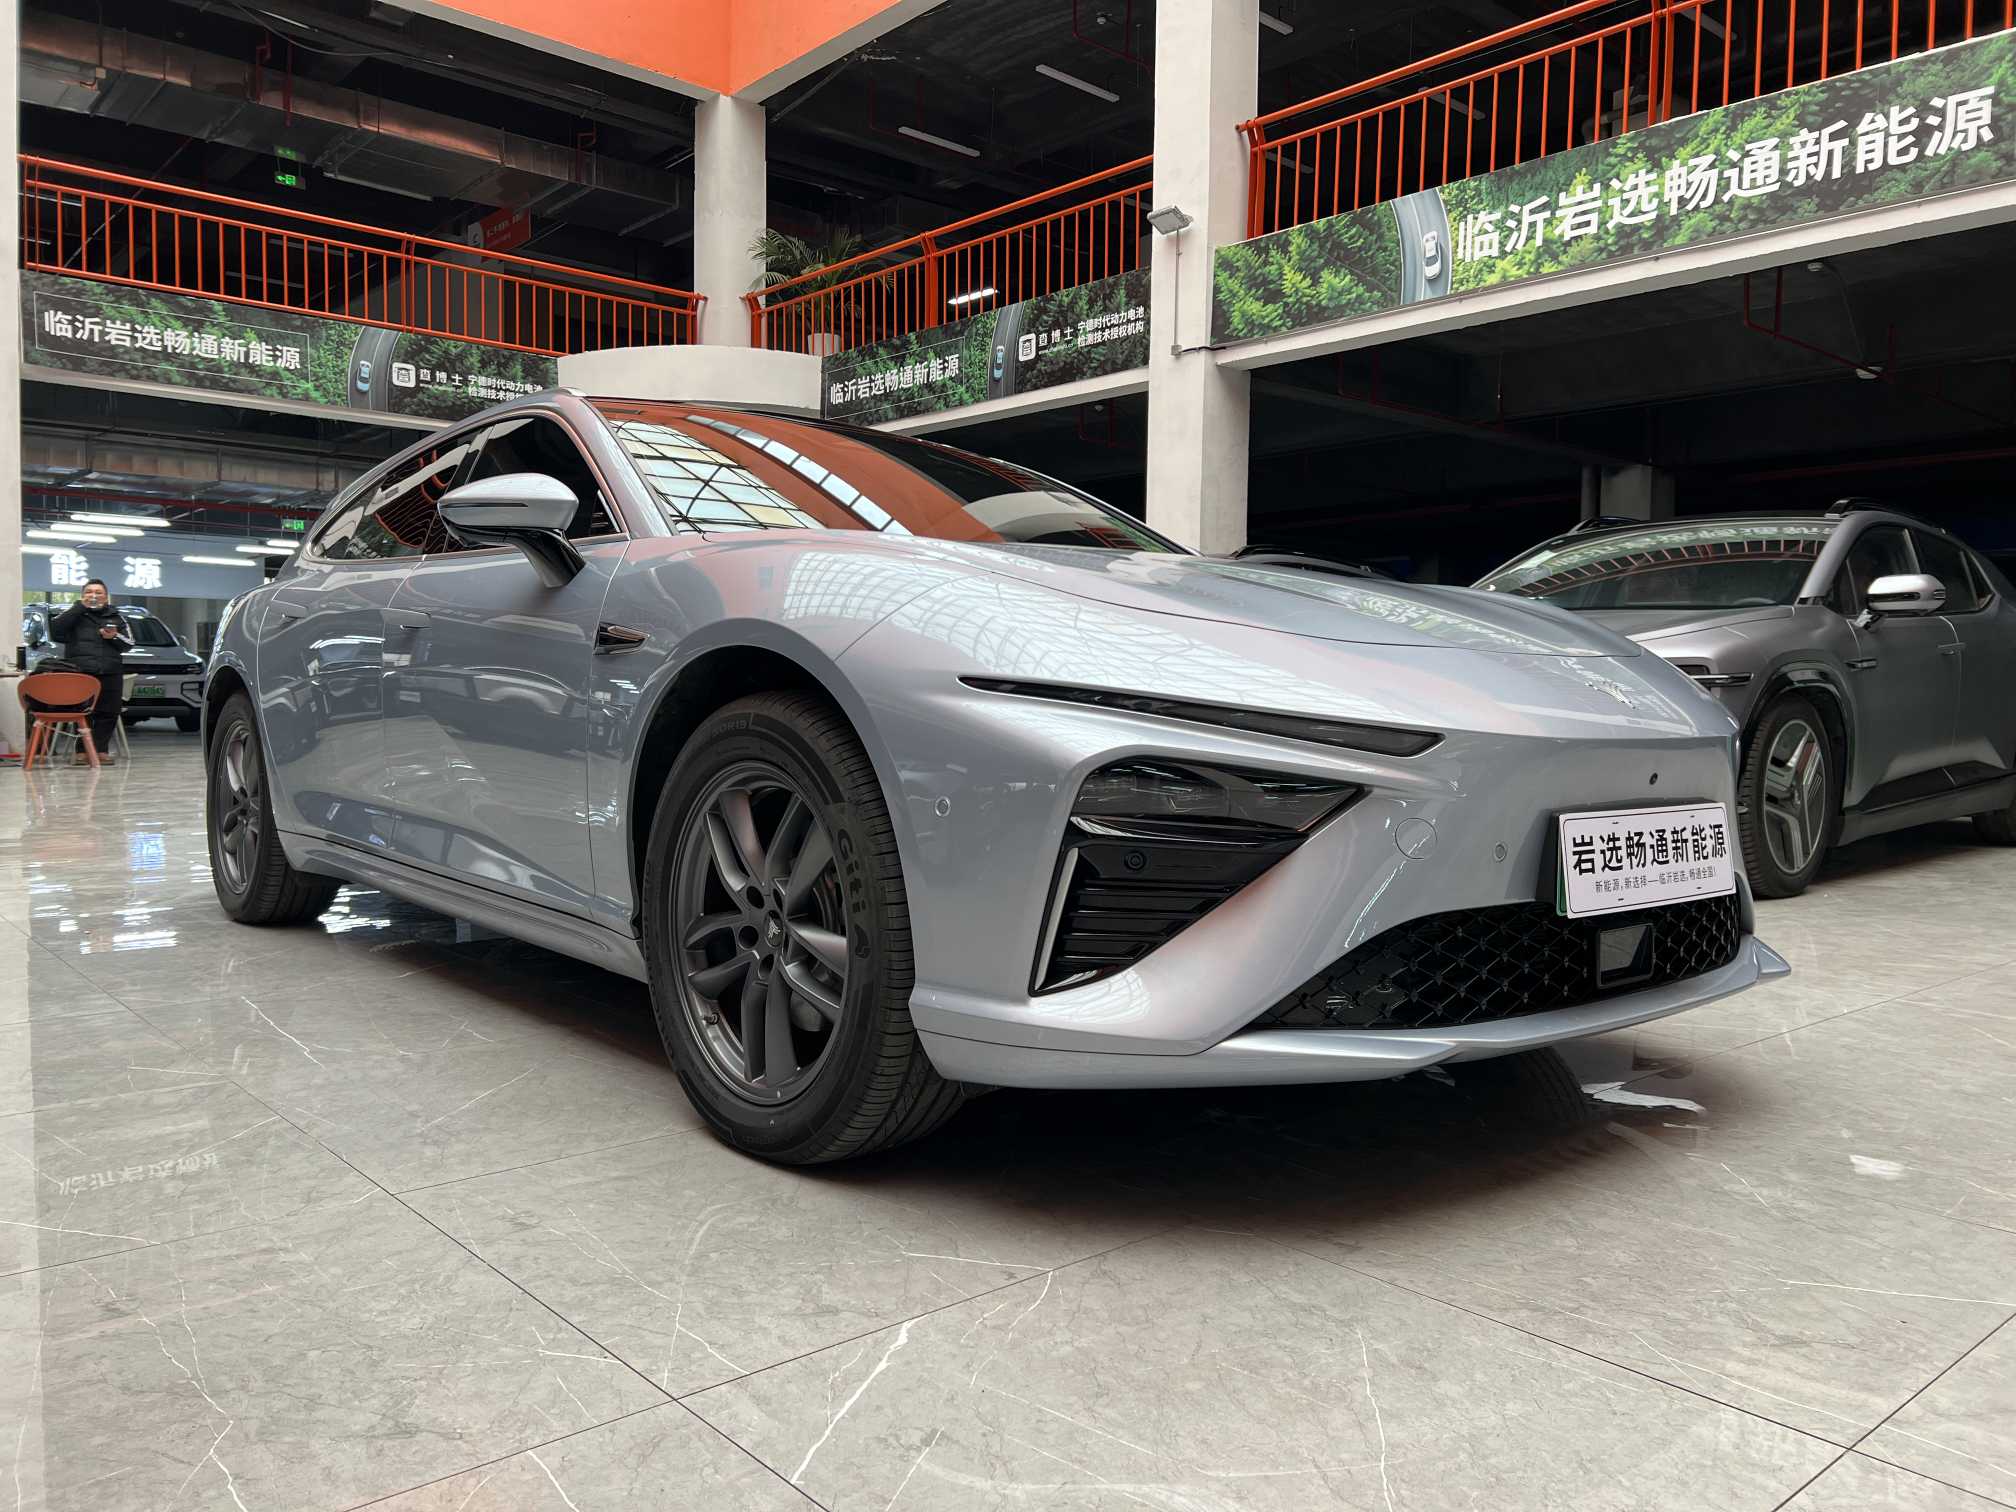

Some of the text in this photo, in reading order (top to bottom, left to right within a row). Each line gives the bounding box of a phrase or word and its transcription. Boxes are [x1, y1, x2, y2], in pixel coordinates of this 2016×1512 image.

[1456, 86, 1996, 263] 临沂岩选畅通新能源
[44, 310, 301, 370] 临沂岩选畅通新能源
[1077, 305, 1145, 334] 宁德时代动力电池
[1077, 321, 1145, 348] 检测技术授权机构
[830, 354, 960, 405] 临沂岩选畅通新能源
[1572, 823, 1727, 876] 岩选畅通新能源
